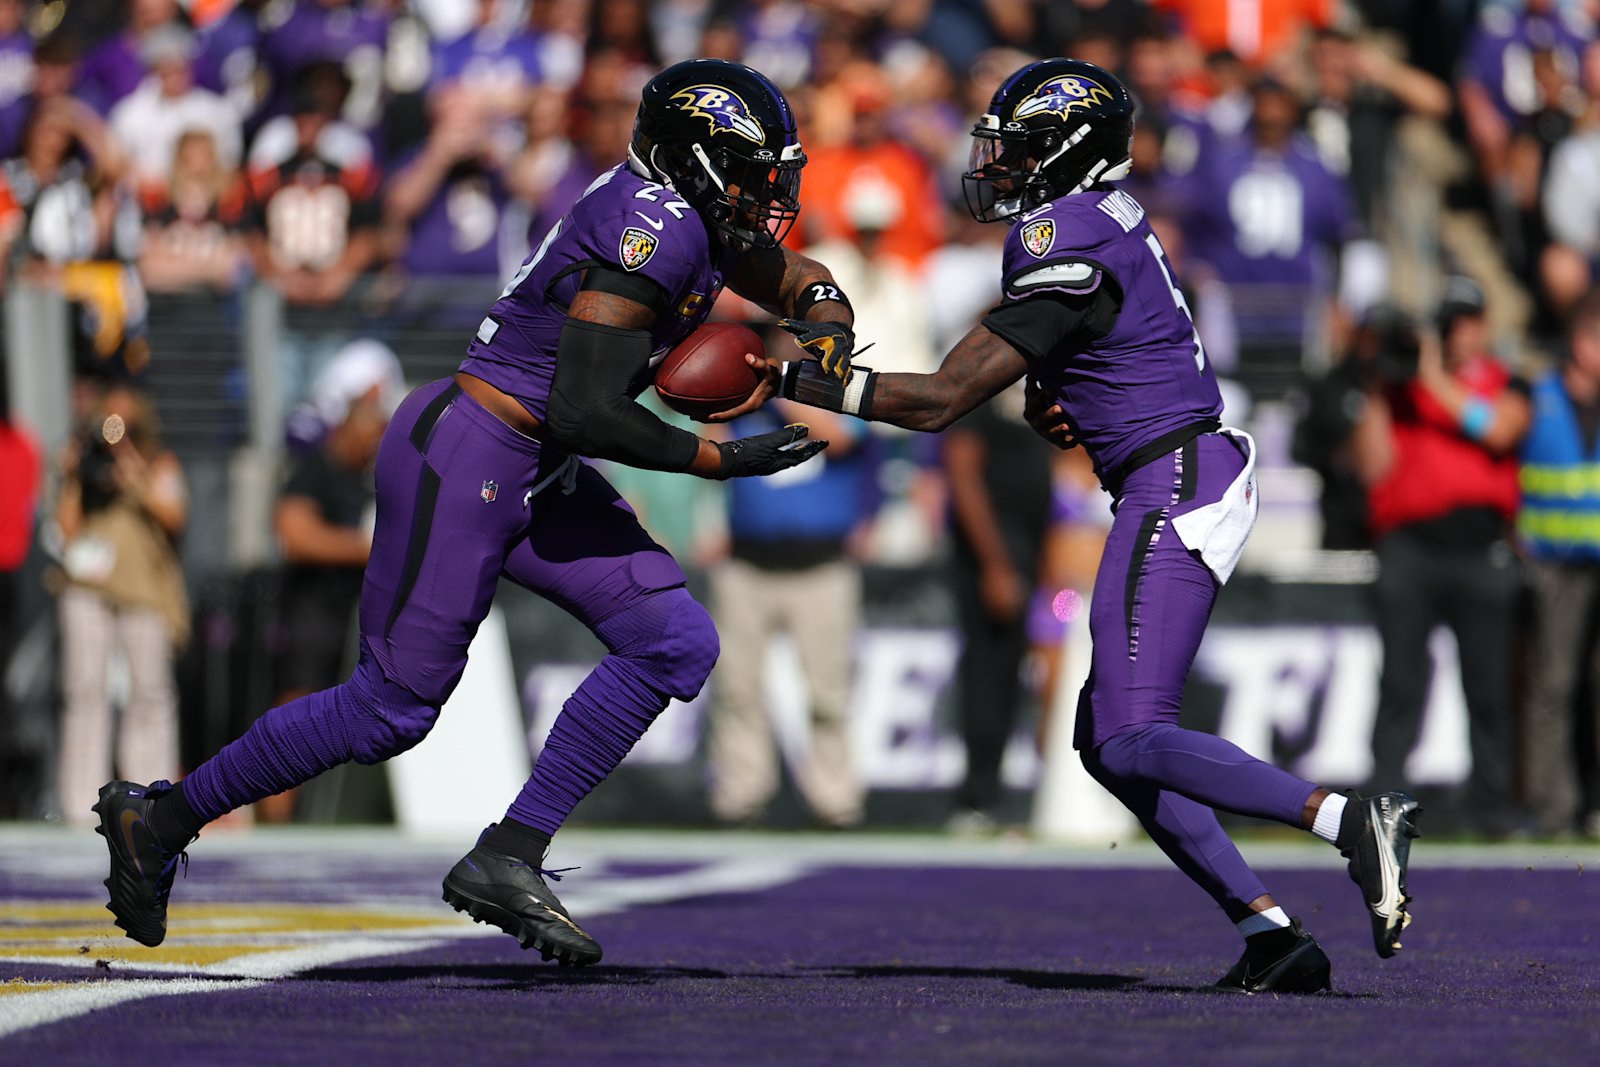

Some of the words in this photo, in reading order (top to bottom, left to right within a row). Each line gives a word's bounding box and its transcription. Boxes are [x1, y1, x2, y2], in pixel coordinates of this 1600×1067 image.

[634, 181, 692, 220] 22
[628, 230, 655, 244] RAVENS
[811, 284, 840, 301] 22
